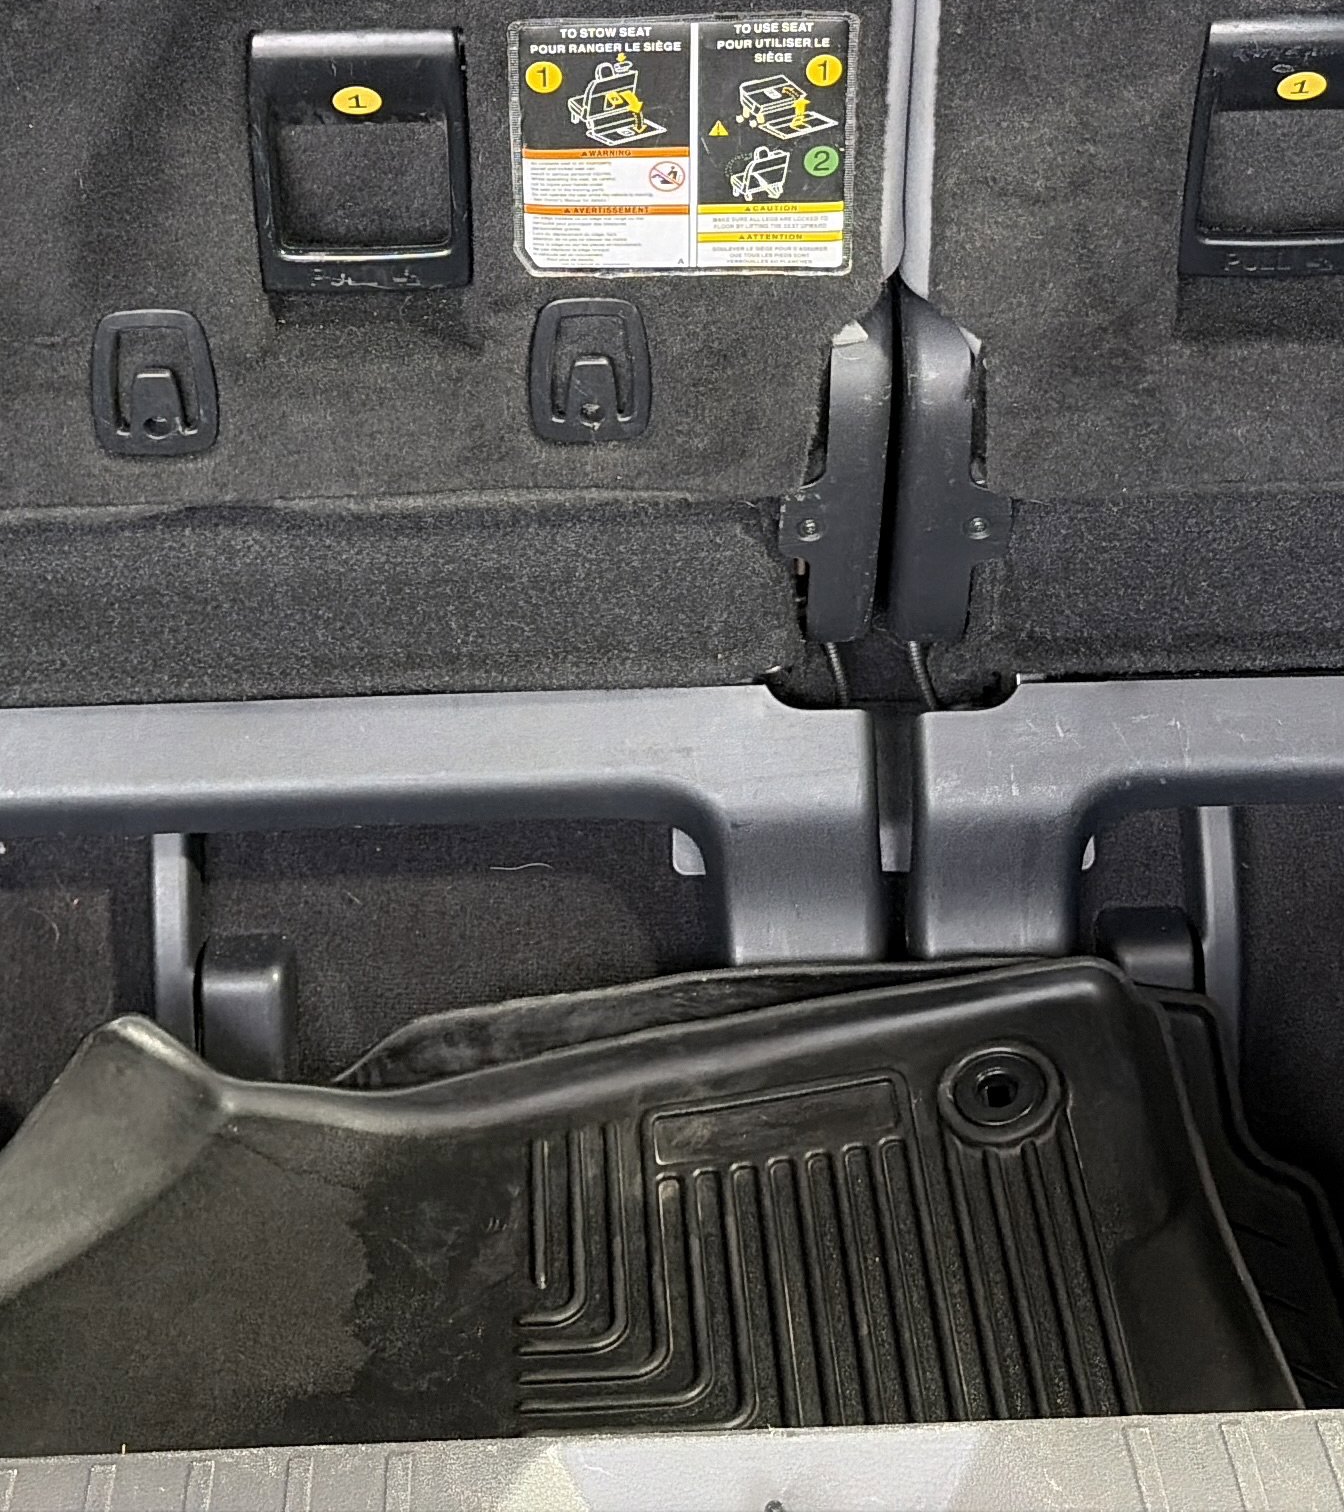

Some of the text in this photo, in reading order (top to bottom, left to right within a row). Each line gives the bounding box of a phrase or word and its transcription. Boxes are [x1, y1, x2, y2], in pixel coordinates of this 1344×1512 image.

[559, 26, 652, 39] TO STOW SEAT
[734, 21, 814, 35] TO USE SEAT
[530, 39, 682, 55] POUR RANGER LE SIÈGE
[716, 37, 831, 50] POUR UTILISER LE
[754, 50, 793, 63] SIÈGE
[588, 149, 632, 157] WARNING
[813, 151, 831, 172] 2
[573, 206, 649, 214] AVERTISSEMENT
